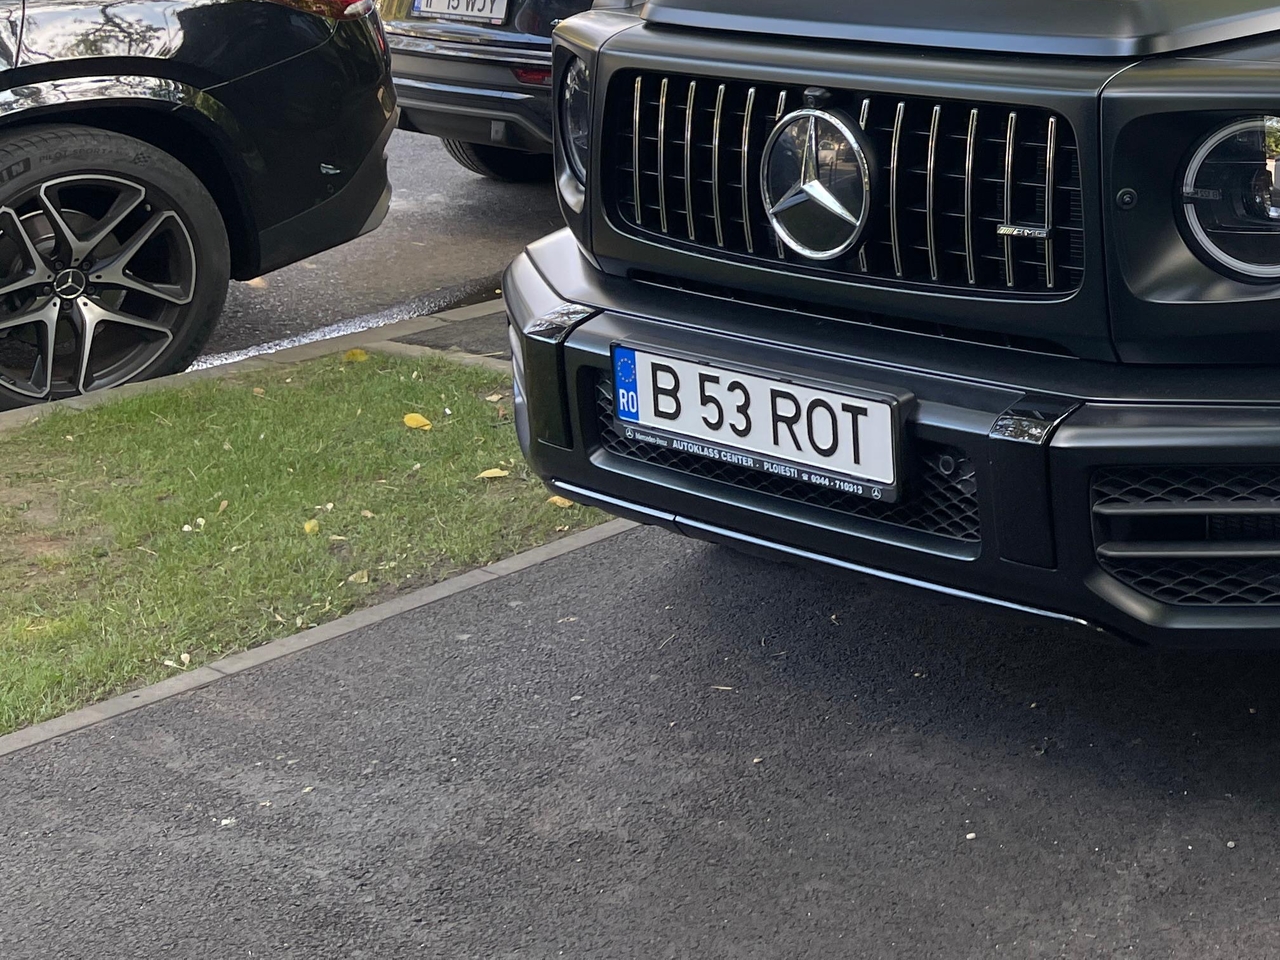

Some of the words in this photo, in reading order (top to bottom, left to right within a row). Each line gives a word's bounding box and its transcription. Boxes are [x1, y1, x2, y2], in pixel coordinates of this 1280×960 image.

[619, 388, 639, 414] RO
[650, 361, 682, 421] B
[698, 372, 752, 438] 53
[769, 387, 868, 466] ROT
[672, 440, 720, 459] AUTOKLASS
[721, 451, 754, 467] CENTER
[764, 462, 798, 478] PLOIESTI
